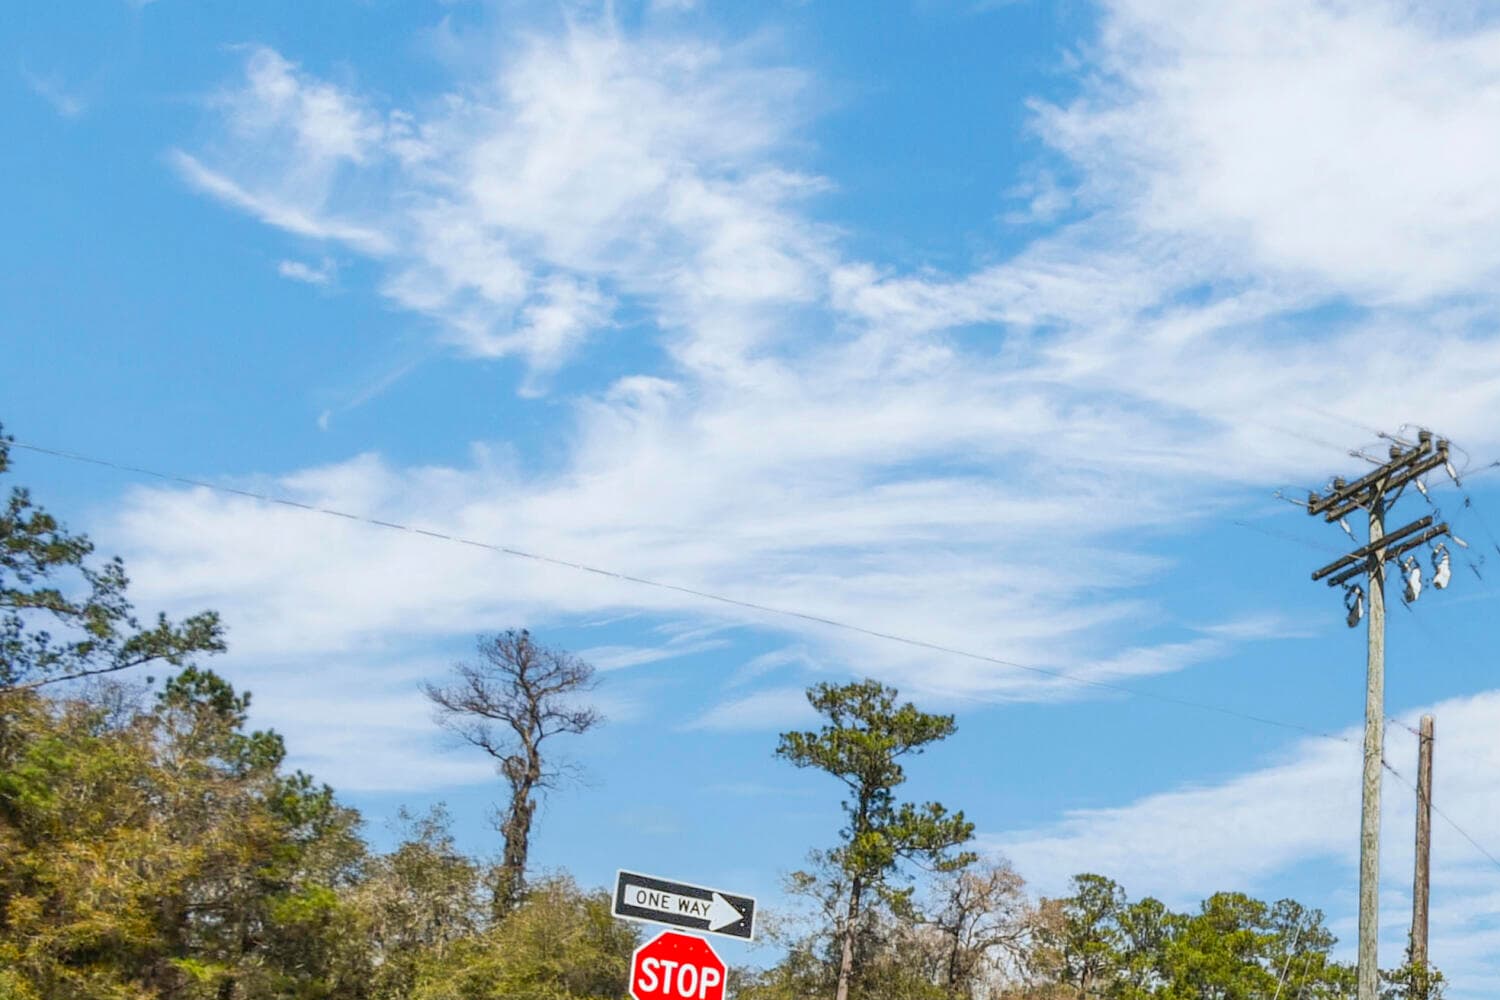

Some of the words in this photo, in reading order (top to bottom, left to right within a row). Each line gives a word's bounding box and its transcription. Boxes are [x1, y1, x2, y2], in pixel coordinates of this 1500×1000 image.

[636, 890, 670, 910] ONE
[677, 898, 711, 918] WAY
[638, 957, 721, 1000] STOP
